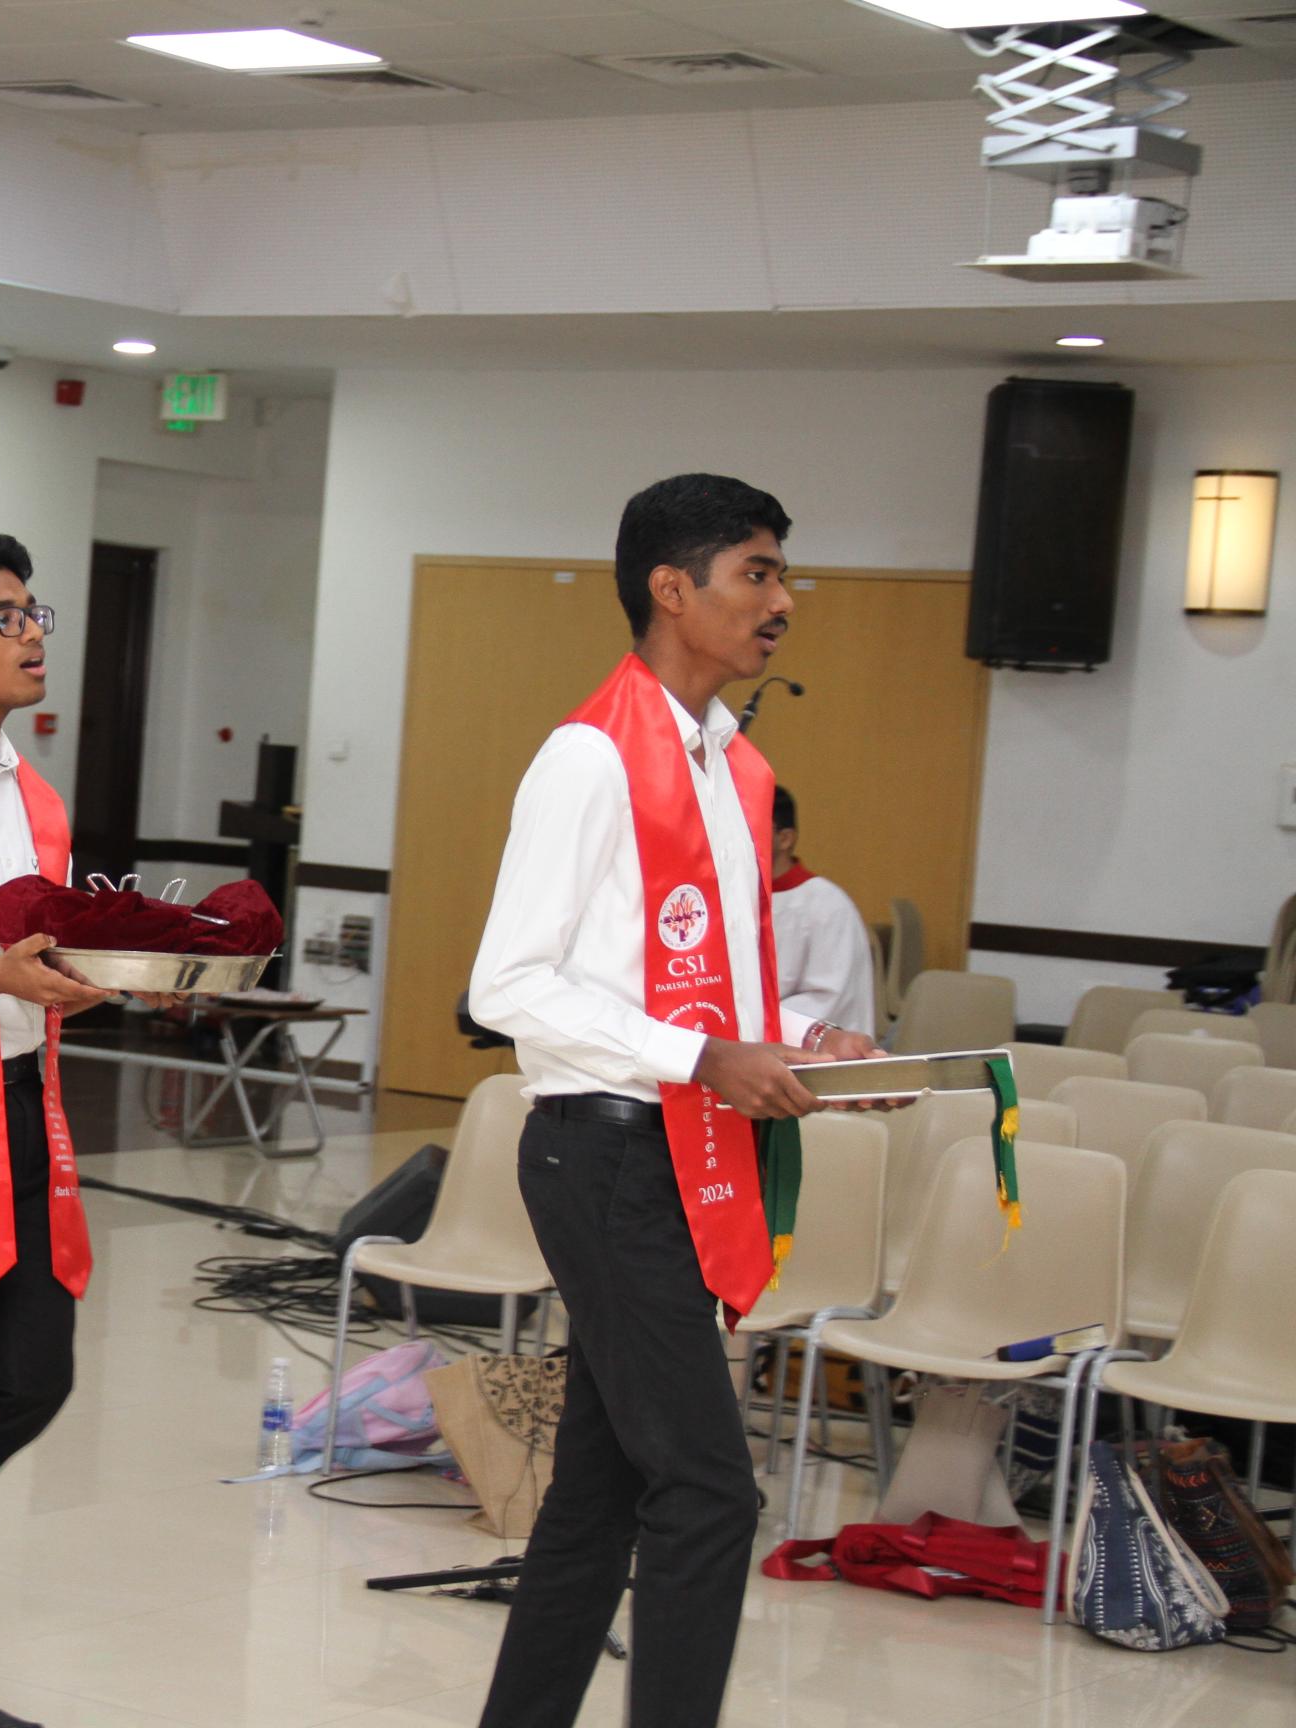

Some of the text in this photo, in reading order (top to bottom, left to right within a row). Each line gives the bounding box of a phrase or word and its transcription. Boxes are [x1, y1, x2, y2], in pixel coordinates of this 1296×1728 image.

[667, 954, 707, 978] CSI
[695, 974, 722, 987] DUBAI
[664, 1001, 727, 1025] NDAY SCHOOL
[698, 1181, 735, 1204] 2024
